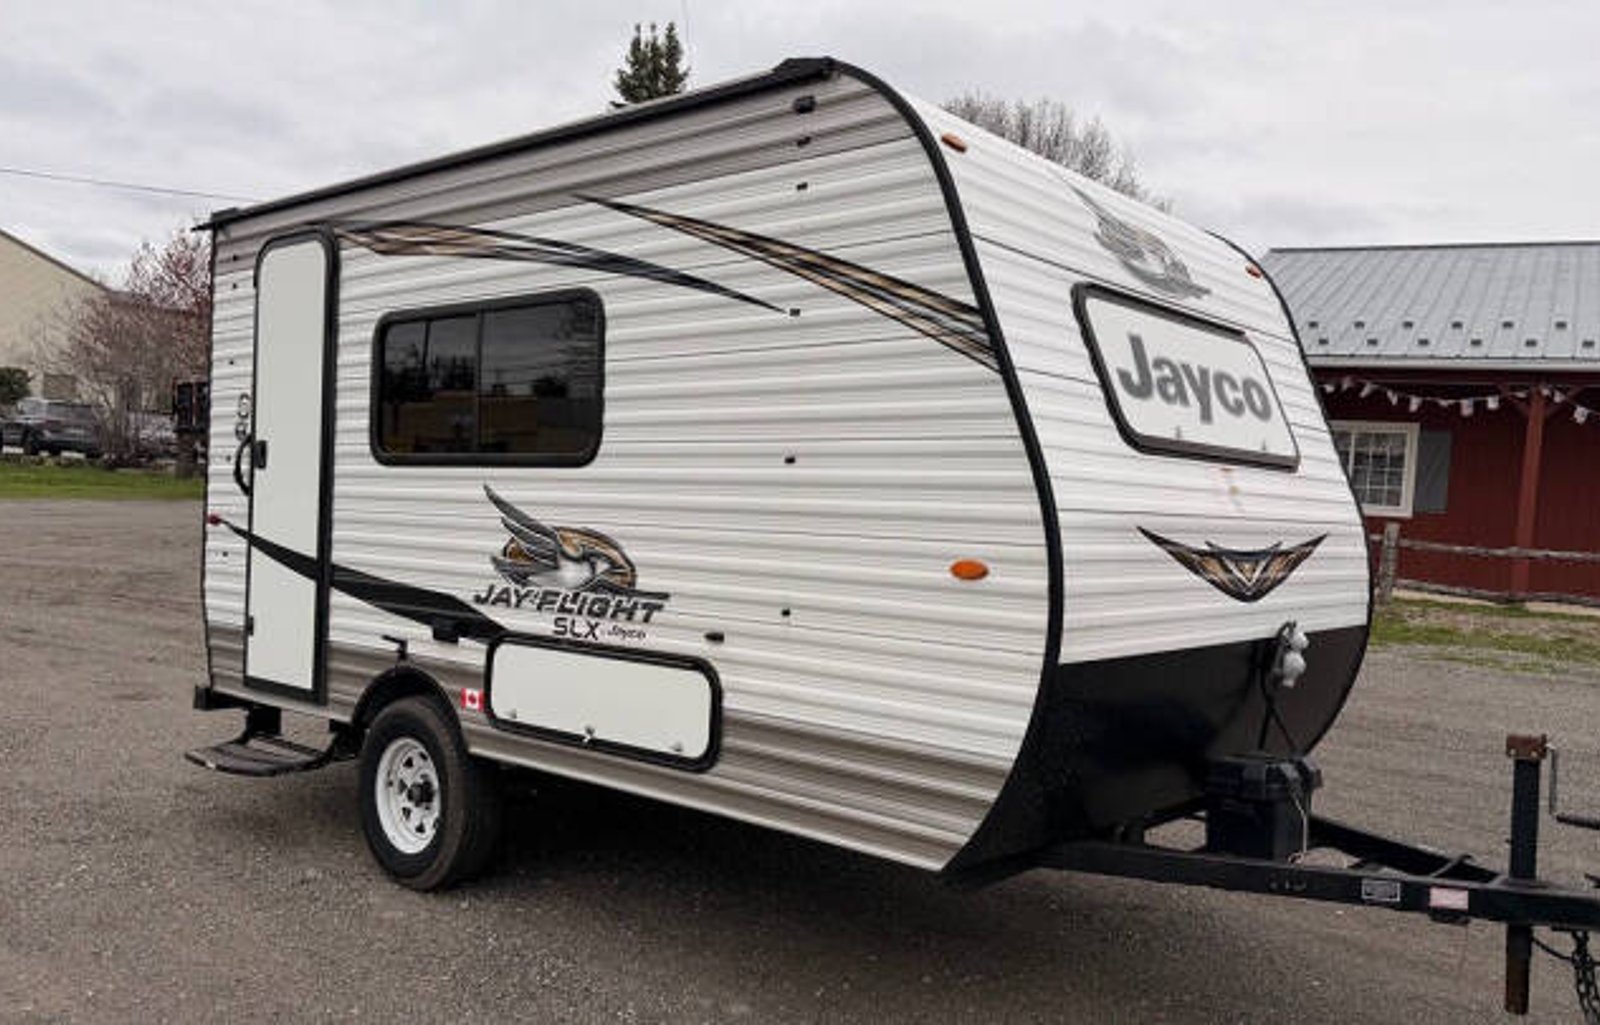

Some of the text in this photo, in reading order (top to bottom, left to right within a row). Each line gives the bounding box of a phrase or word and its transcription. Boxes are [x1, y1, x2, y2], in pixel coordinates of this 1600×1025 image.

[1116, 333, 1272, 424] Jayco
[536, 590, 664, 623] FLIGHT
[553, 617, 600, 640] SLX
